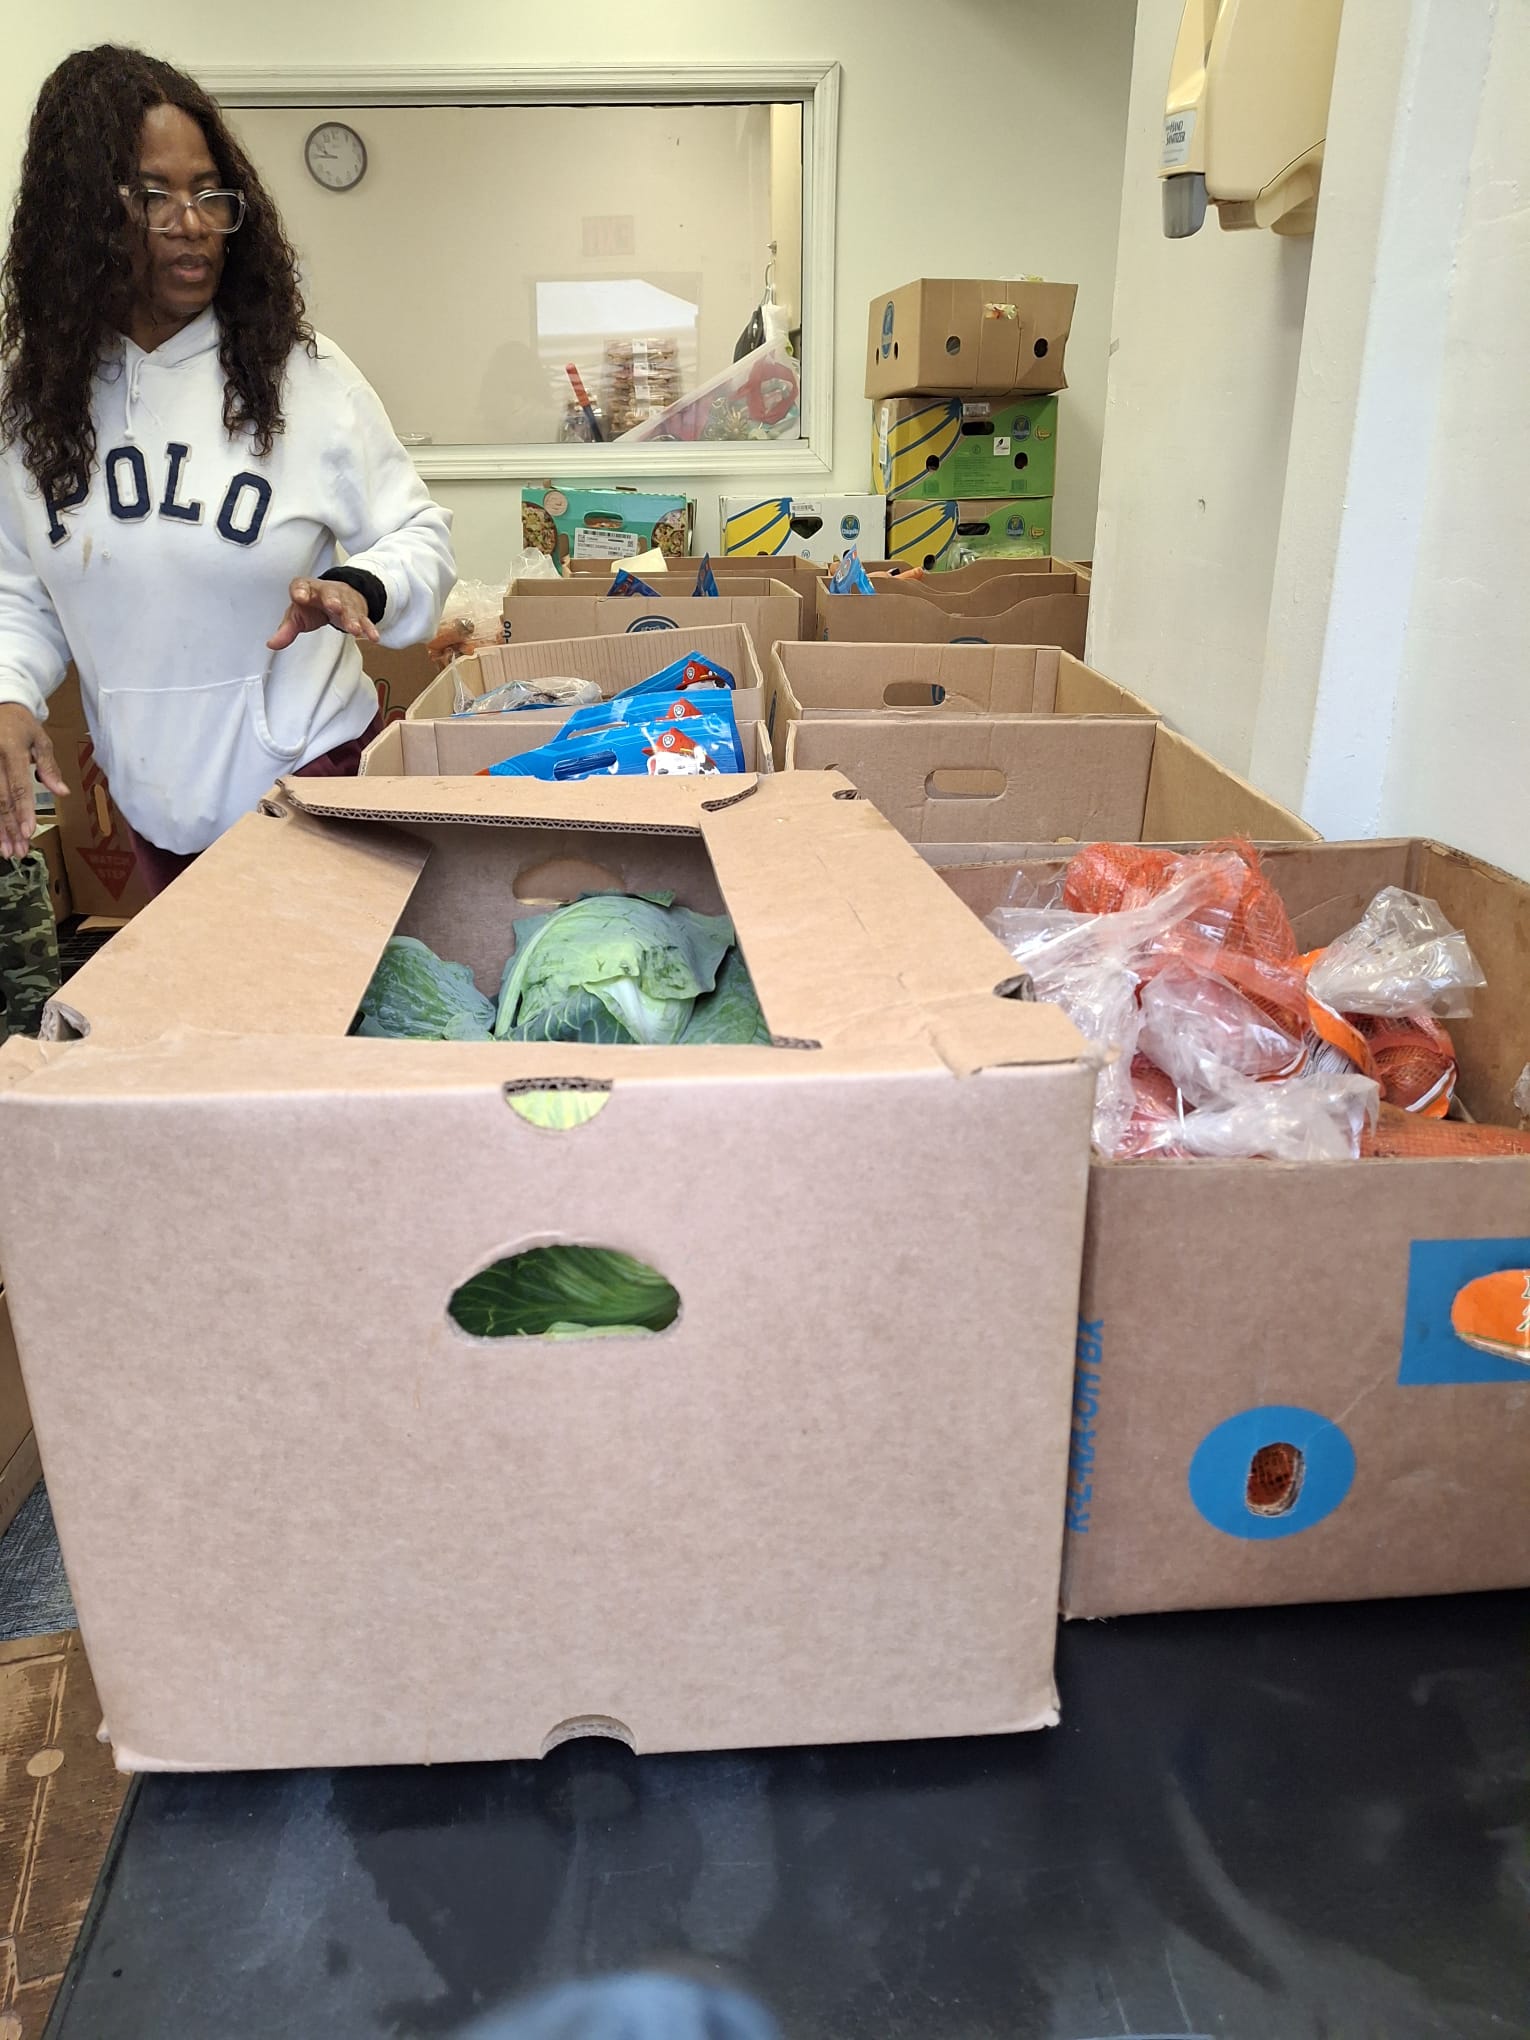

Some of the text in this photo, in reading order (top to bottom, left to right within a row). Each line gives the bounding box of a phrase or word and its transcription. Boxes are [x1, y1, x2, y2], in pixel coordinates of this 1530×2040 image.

[1169, 120, 1183, 133] HAND
[45, 441, 274, 548] POLO
[97, 868, 127, 880] STEP
[1078, 1318, 1104, 1363] BX
